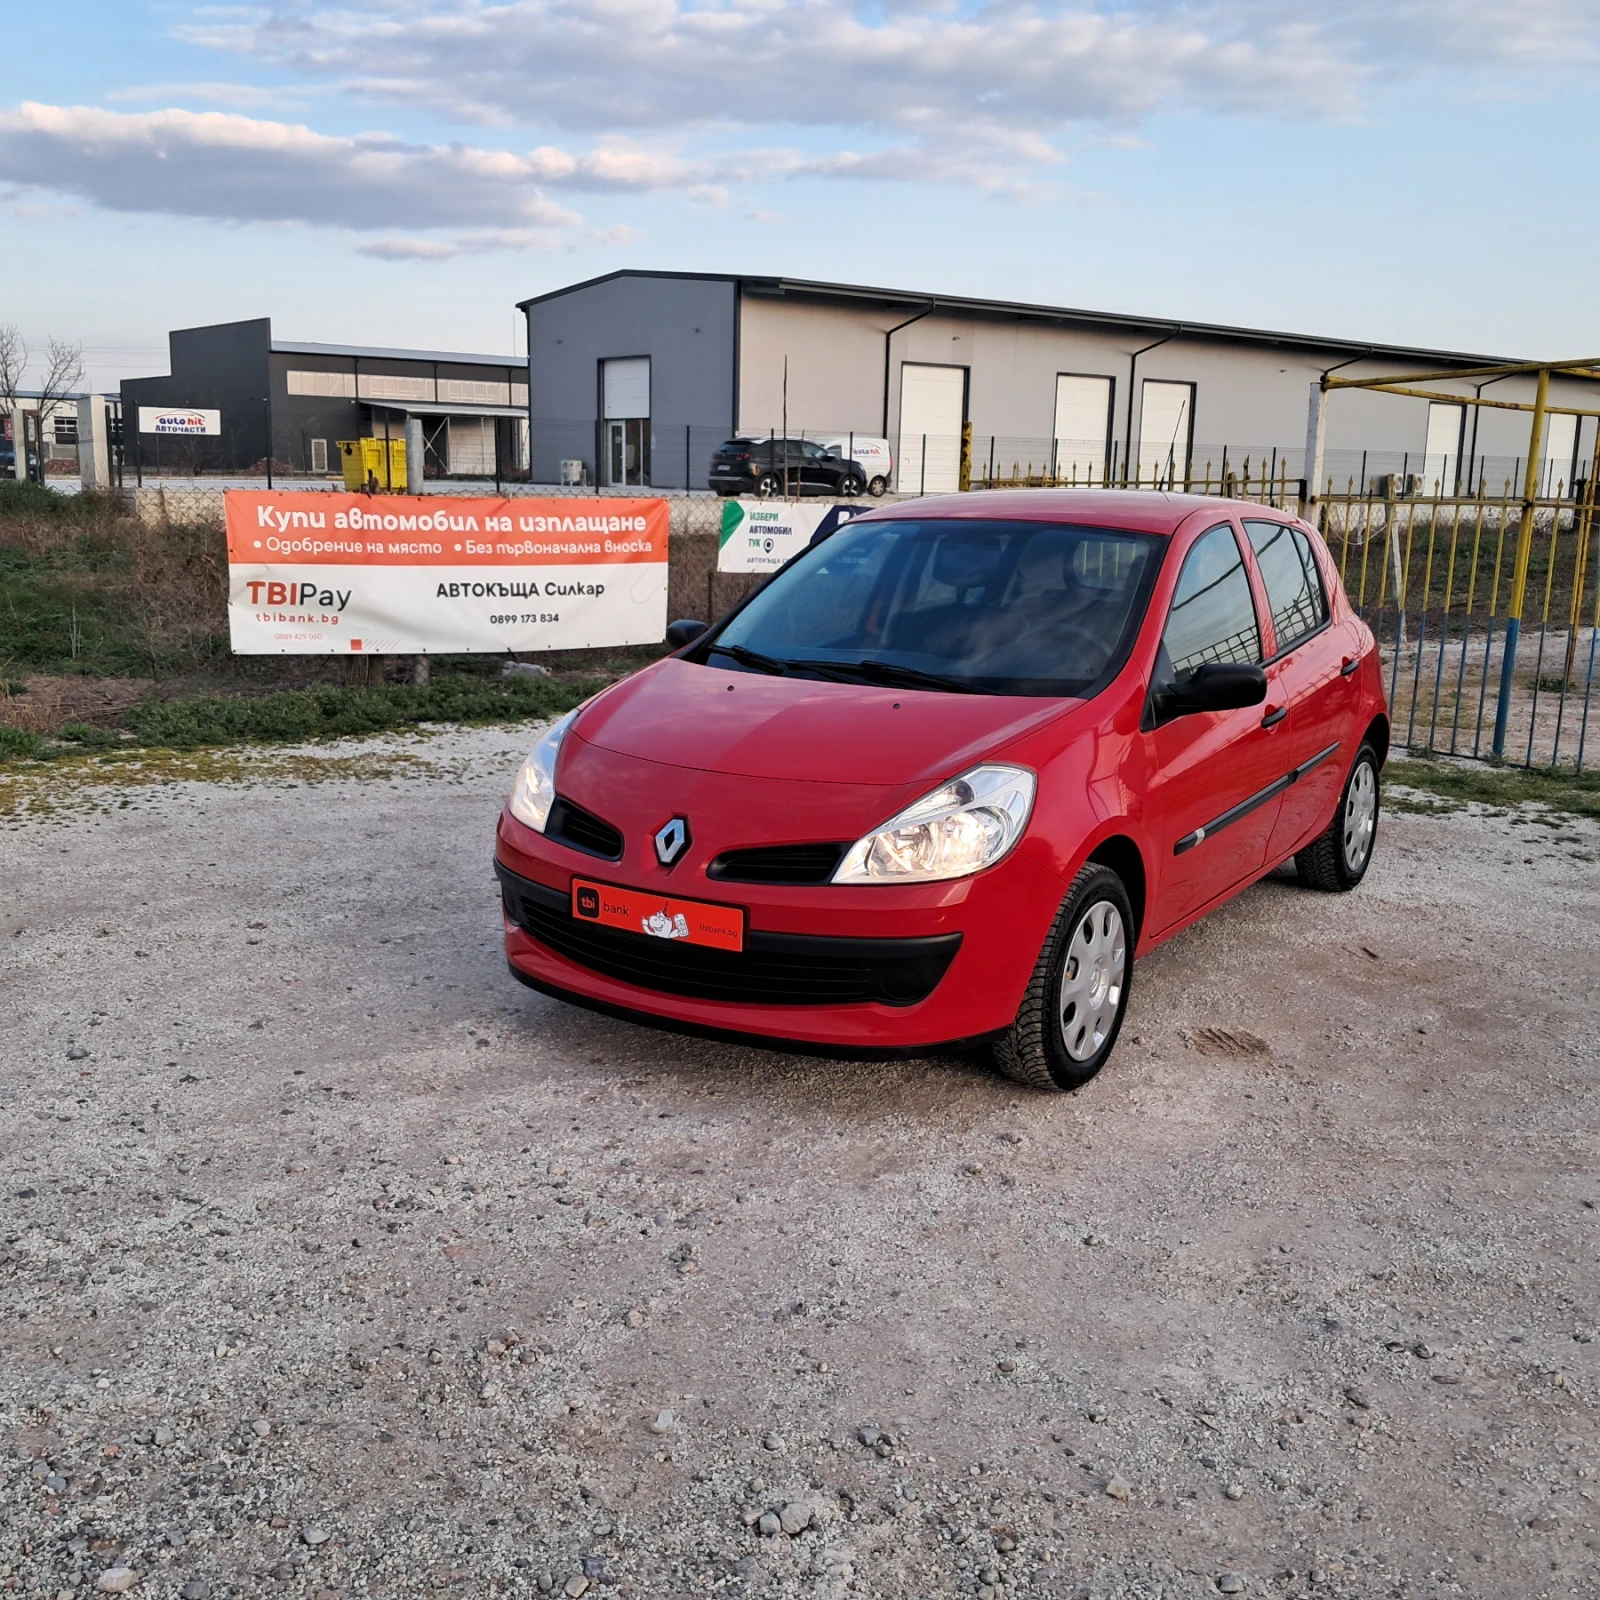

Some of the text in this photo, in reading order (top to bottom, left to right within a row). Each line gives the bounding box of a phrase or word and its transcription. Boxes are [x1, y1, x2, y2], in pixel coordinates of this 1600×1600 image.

[159, 417, 204, 426] auto hit
[155, 425, 206, 433] АВТОЧАСТИ
[257, 505, 647, 535] Купи автомобил на изплащане
[749, 512, 779, 522] ИЗБЕРИ
[749, 525, 793, 536] АВТОМОБИЛ
[266, 536, 652, 557] Одобрение на място Без първоначална вноска
[748, 538, 761, 547] ТУК
[747, 557, 781, 565] АВТОКЪЩА
[436, 581, 605, 599] АВТОКЪЩА Силкар
[246, 581, 352, 612] TBIPay
[255, 612, 339, 625] tbibank.bg
[490, 613, 560, 624] 0899 173 834
[581, 896, 629, 916] tbi bank
[700, 924, 738, 939] tbibank.bg
